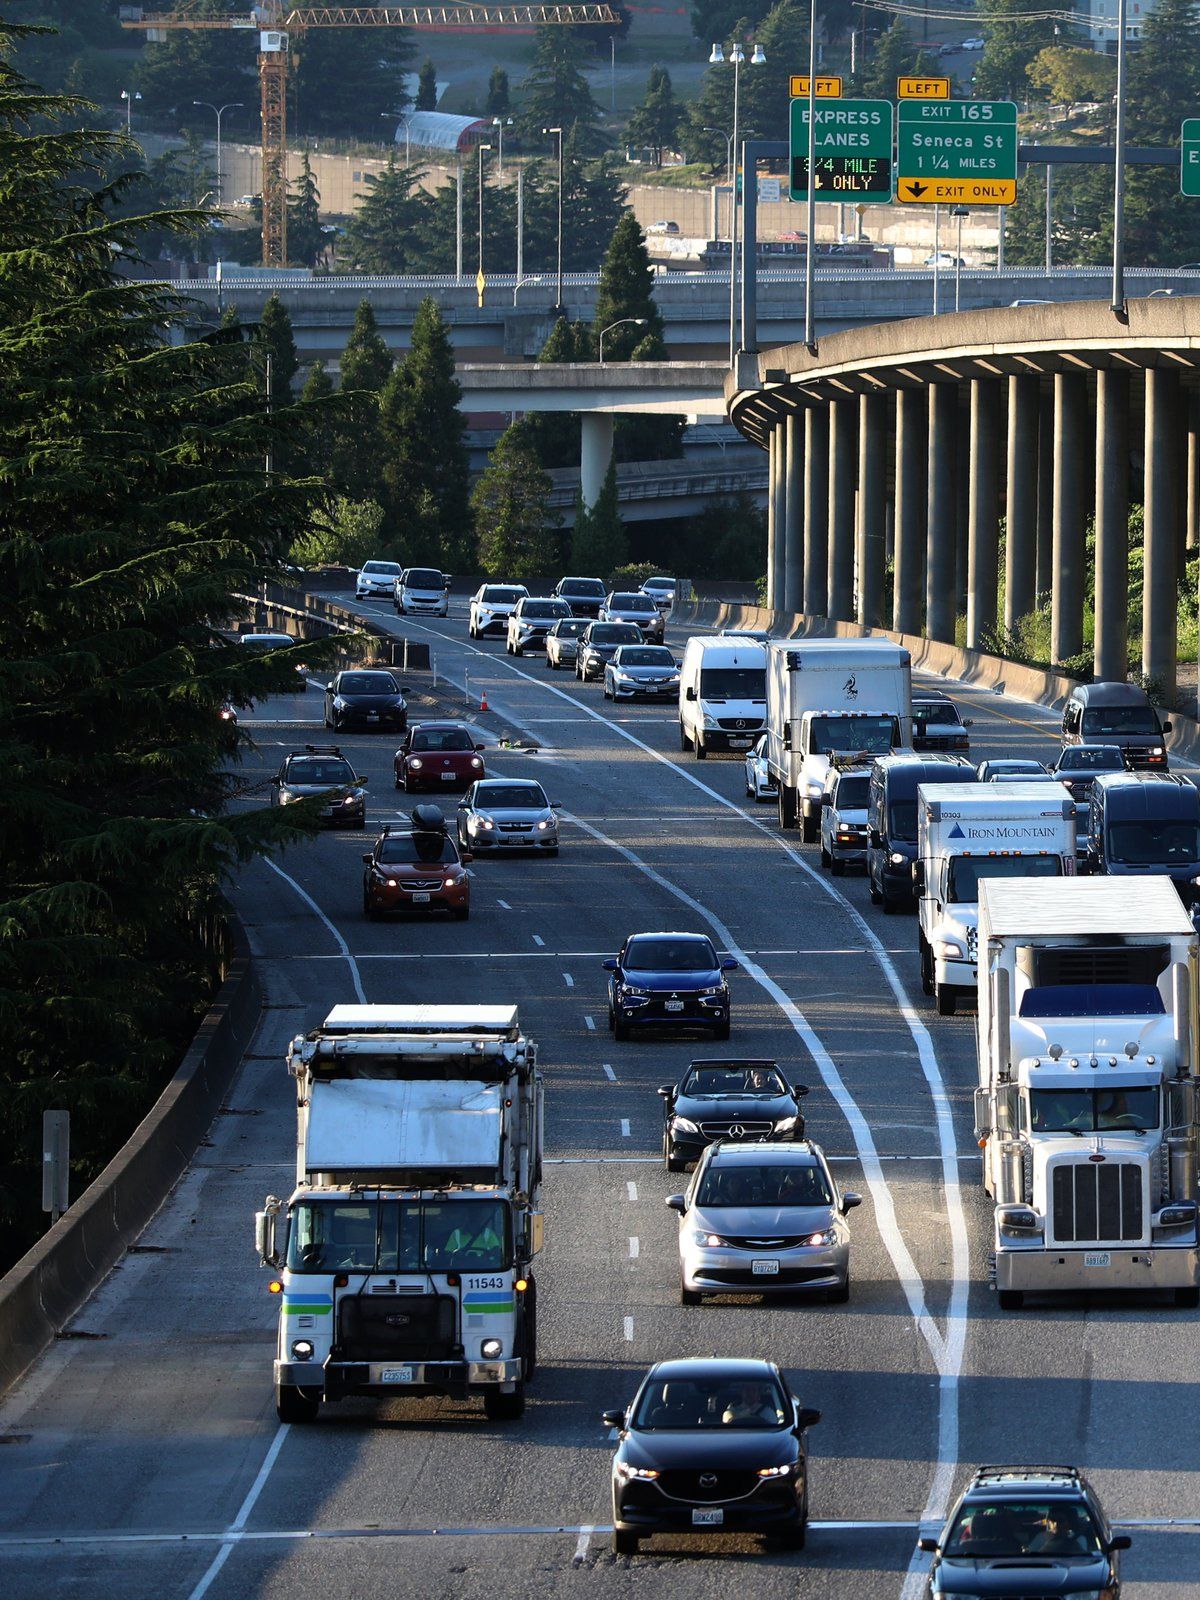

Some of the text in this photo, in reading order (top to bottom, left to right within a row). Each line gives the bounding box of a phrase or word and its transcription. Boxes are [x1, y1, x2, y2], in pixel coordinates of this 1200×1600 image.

[906, 84, 940, 94] LEFT
[922, 105, 993, 120] EXIT 165
[912, 133, 1004, 149] Seneca St
[959, 158, 996, 169] MILES
[1189, 150, 1199, 164] E
[844, 158, 878, 173] MILE
[833, 174, 872, 190] ONLY
[936, 186, 1007, 197] EXIT ONLY
[968, 827, 1055, 839] IRON MOUNTAIN
[468, 1277, 503, 1289] 11543
